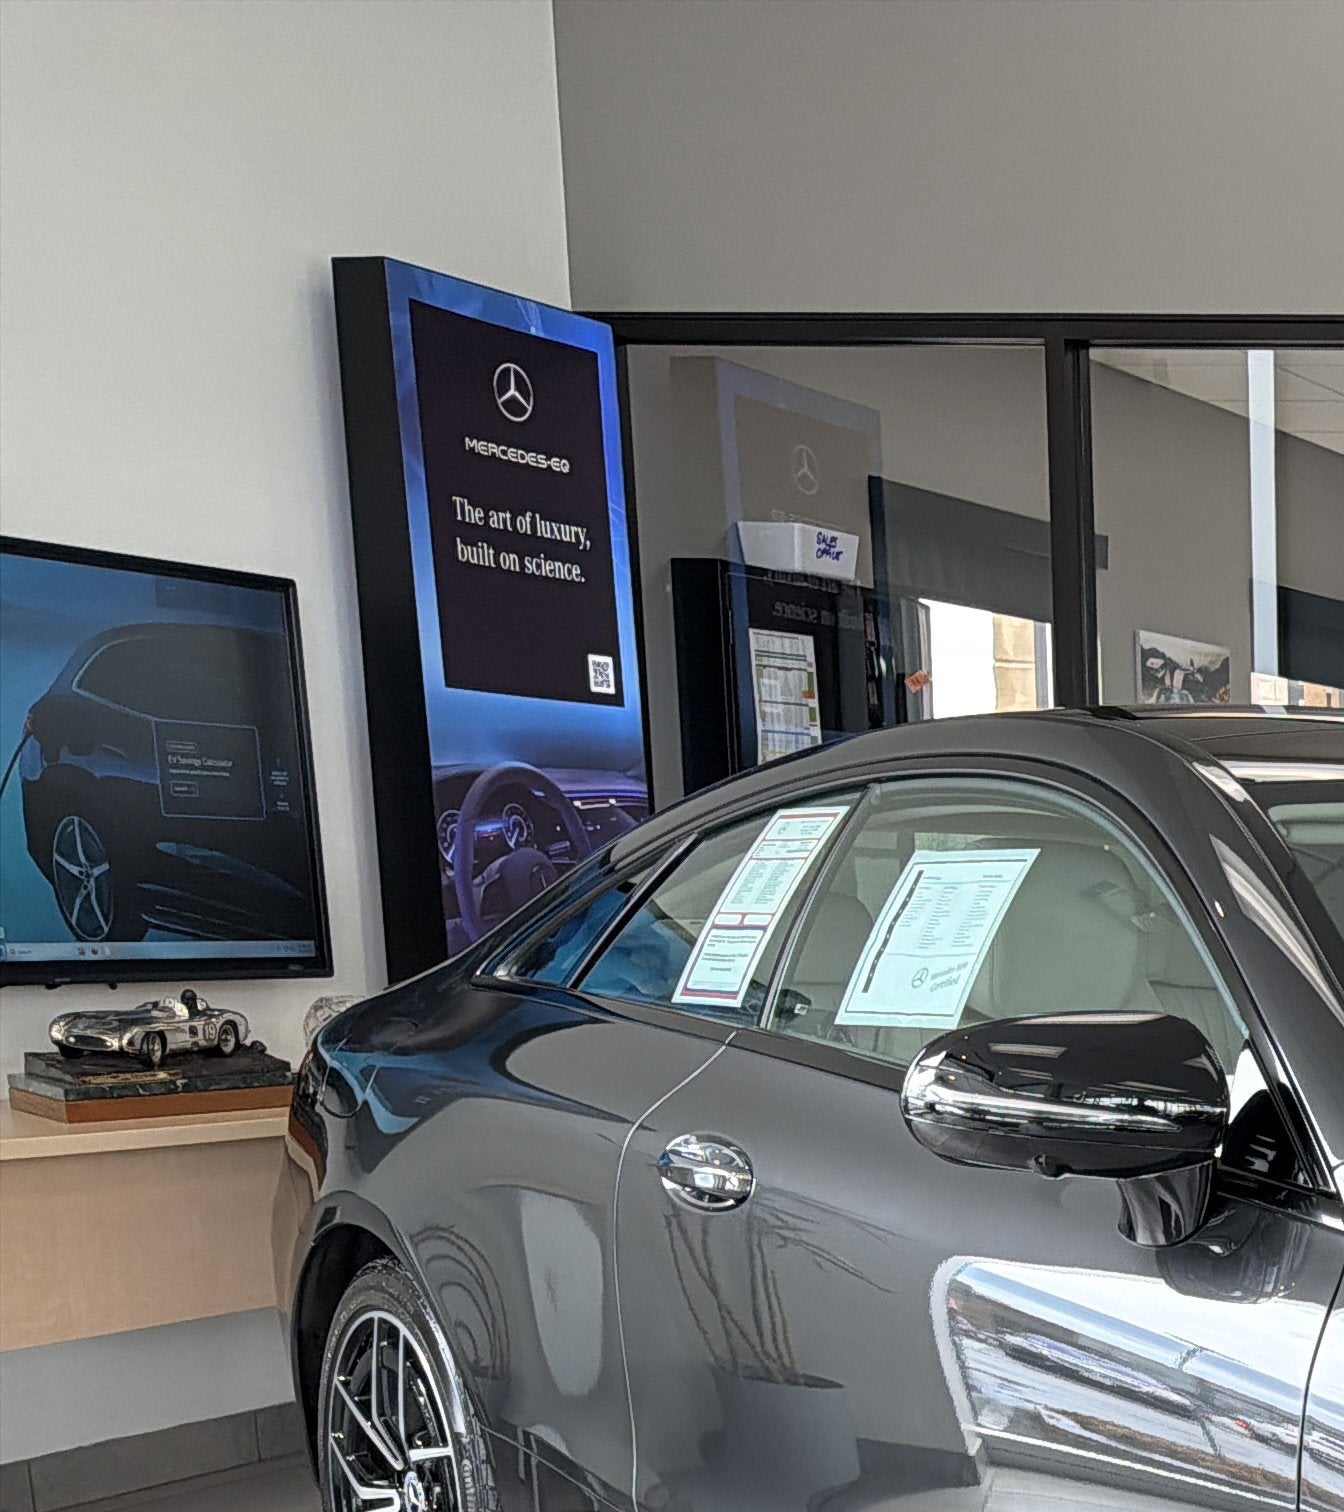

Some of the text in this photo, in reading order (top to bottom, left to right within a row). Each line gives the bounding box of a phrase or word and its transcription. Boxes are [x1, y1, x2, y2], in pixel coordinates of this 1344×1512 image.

[464, 436, 570, 473] MERCEDES-EQ
[452, 495, 592, 551] The art of luxury,
[456, 536, 586, 583] built on science.
